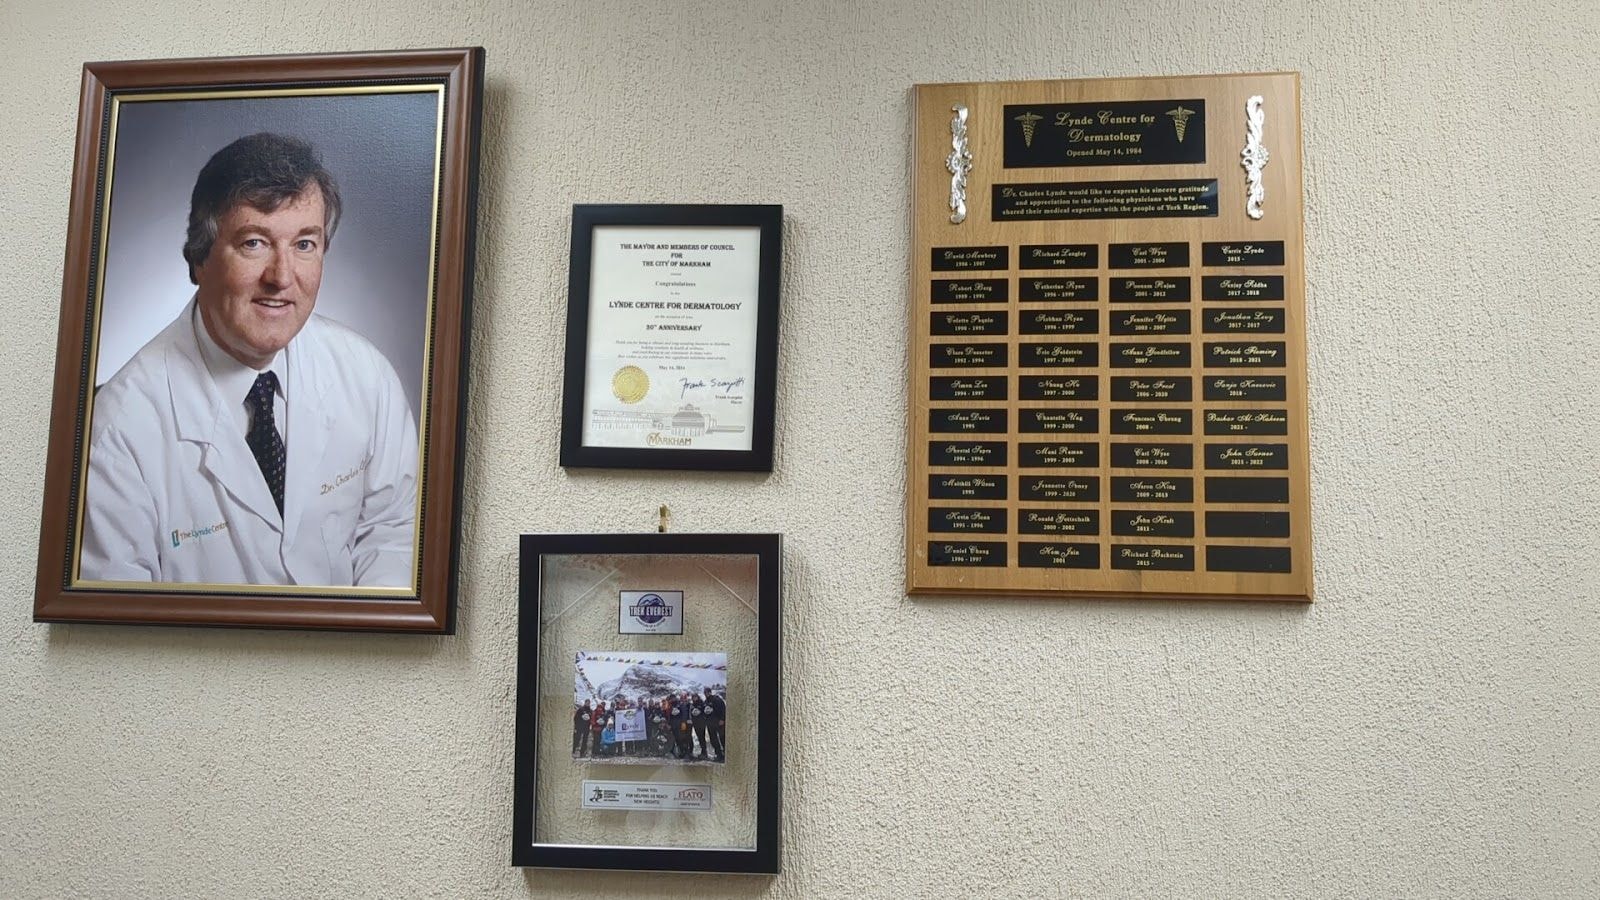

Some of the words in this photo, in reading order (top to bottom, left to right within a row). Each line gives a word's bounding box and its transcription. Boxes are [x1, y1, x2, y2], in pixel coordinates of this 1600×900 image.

[1055, 112, 1093, 127] Lynde
[1097, 111, 1136, 124] Centre
[1140, 114, 1155, 123] for
[1069, 129, 1141, 142] Dermatology
[1002, 188, 1017, 197] Dr.
[1033, 249, 1059, 257] Richard
[1243, 246, 1264, 254] Lynde
[1124, 315, 1153, 325] Jennifer
[1214, 312, 1250, 322] Jonathan
[1255, 312, 1273, 322] Levy
[1213, 347, 1241, 355] Patrick
[1244, 346, 1277, 357] Fleming
[1129, 381, 1150, 389] Peter
[1152, 381, 1175, 389] Frost
[647, 433, 691, 446] MARKHAM
[1220, 448, 1242, 459] John
[320, 484, 335, 495] Dr.
[1130, 515, 1150, 526] John
[191, 528, 212, 538] Lynde
[1122, 549, 1148, 558] Richard
[631, 607, 645, 616] TREK
[647, 607, 672, 616] EVEREST
[678, 791, 703, 799] FLATO
